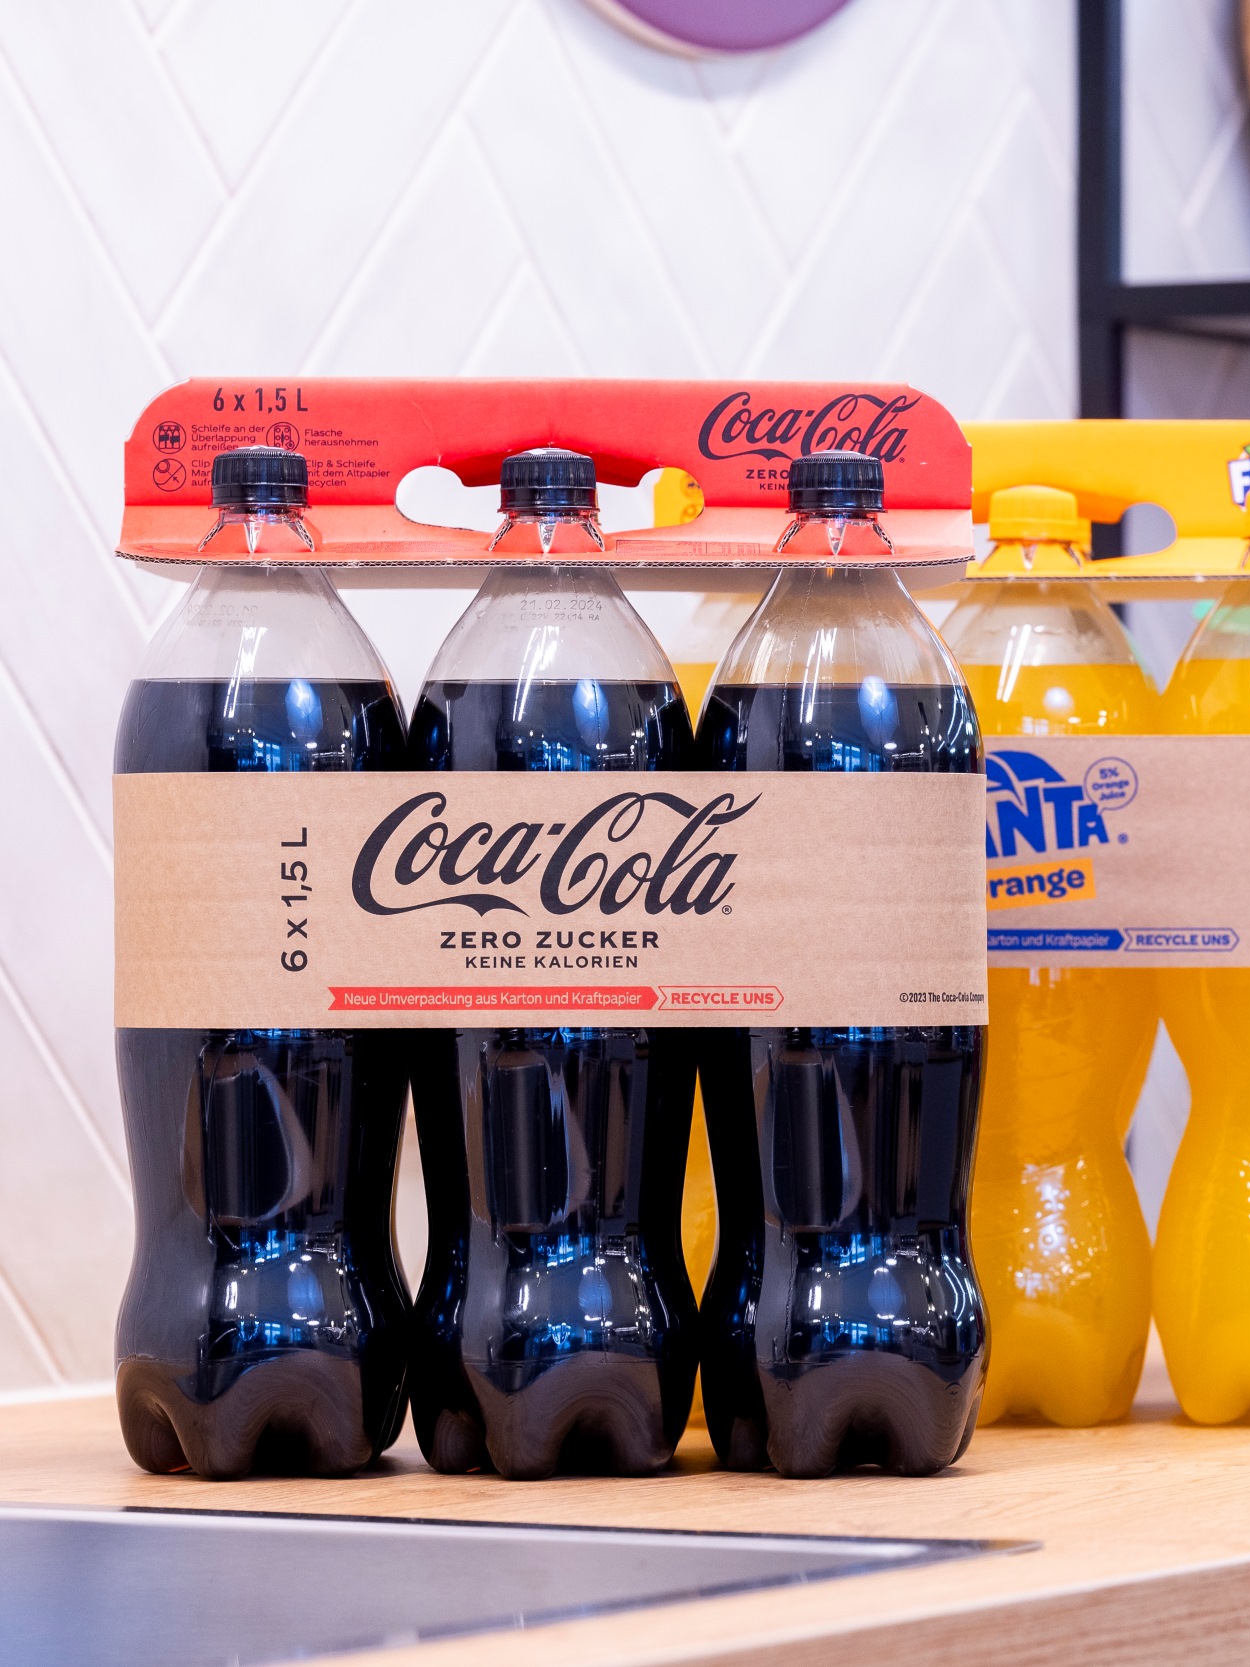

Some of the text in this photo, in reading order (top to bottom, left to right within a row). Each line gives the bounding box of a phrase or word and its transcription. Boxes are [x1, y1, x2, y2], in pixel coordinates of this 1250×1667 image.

[213, 387, 309, 414] 6 x 1,5 L
[191, 424, 232, 433] Schleife
[248, 424, 265, 433] der
[304, 428, 343, 437] Flasche
[698, 391, 922, 464] Coca-Cola
[191, 431, 256, 443] Überlappung
[304, 438, 379, 447] herausnehmen
[191, 459, 211, 469] Clip
[306, 459, 376, 469] Clip & Schleife
[322, 469, 344, 477] dem
[346, 469, 391, 479] Altpapier
[308, 479, 347, 488] ecyclen
[520, 599, 603, 612] 21.02.2024
[1091, 779, 1131, 791] Orange
[1098, 790, 1127, 802] Juice
[986, 785, 1110, 859] NTA
[352, 791, 764, 918] Coca-Cola
[987, 868, 1086, 899] range
[280, 826, 312, 972] 6 x 1,5 L
[439, 931, 660, 949] ZERO ZUCKER
[1021, 933, 1044, 947] und
[1045, 932, 1111, 949] Kraftpapier
[1135, 934, 1231, 947] RECYCLE UNS
[464, 955, 639, 969] KEINE KALORIEN
[344, 991, 642, 1008] Neue Umverpackung aus Karton und Kraftpapier
[670, 992, 775, 1005] RECYCLE UNS
[928, 992, 941, 1002] The
